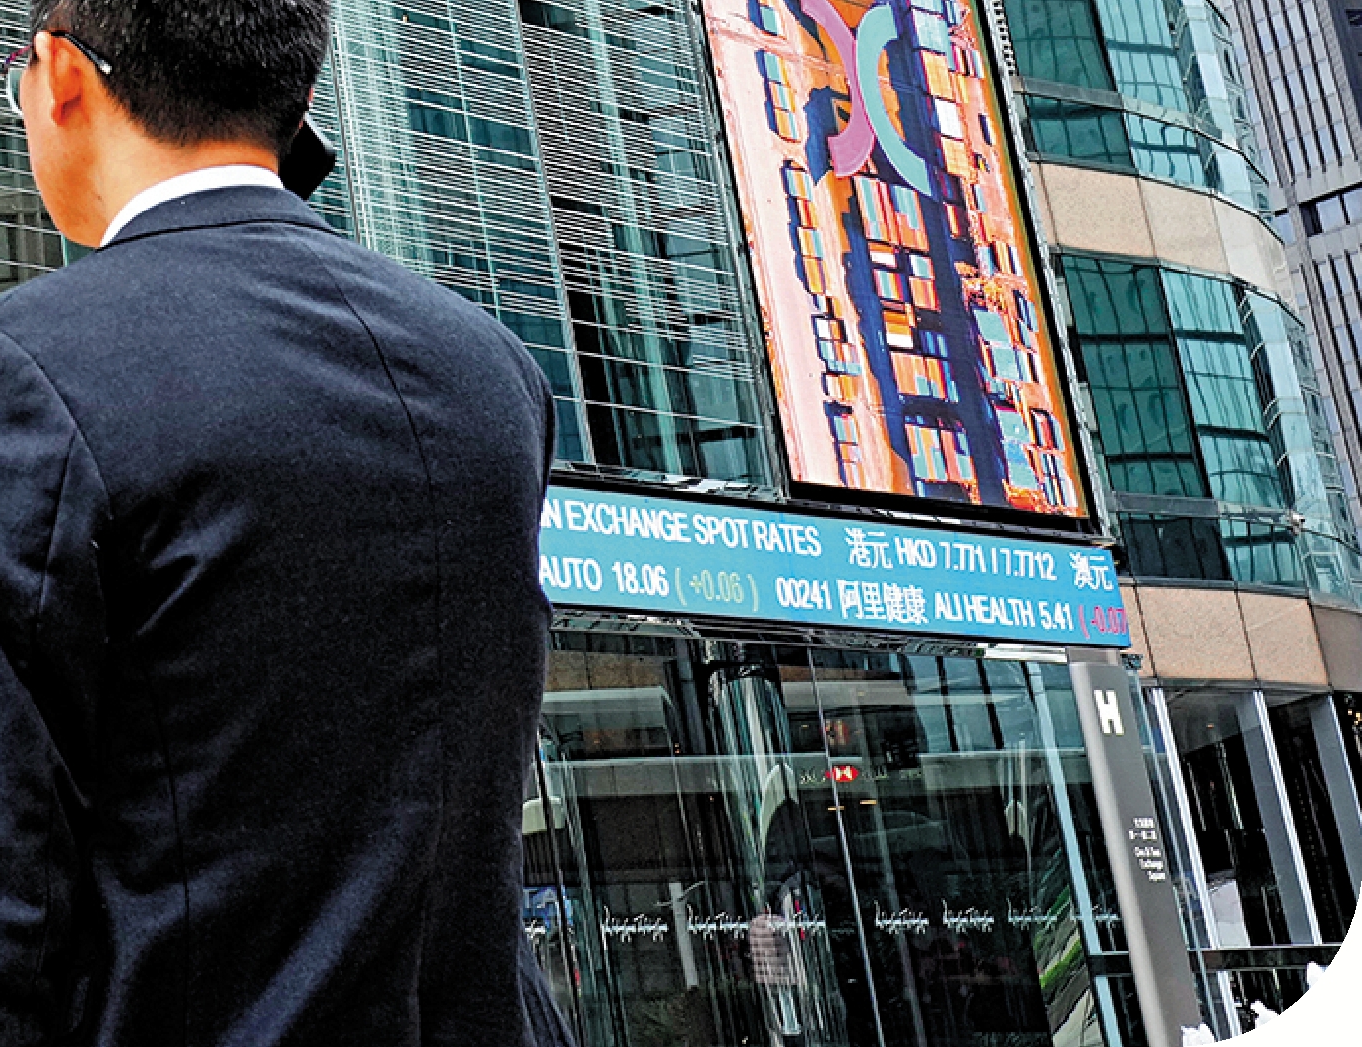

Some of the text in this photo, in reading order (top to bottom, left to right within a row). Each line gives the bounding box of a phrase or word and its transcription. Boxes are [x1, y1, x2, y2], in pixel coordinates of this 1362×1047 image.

[564, 500, 692, 543] EXCHANGE
[693, 514, 749, 548] SPOT
[752, 520, 822, 557] RATES
[845, 527, 893, 569] 港元
[895, 537, 936, 567] HKD
[538, 555, 603, 591] AUTO
[611, 561, 670, 596] 18.06
[776, 577, 832, 610] 00241
[837, 579, 928, 624] 阿里健康
[964, 594, 1036, 627] HEALTH
[1039, 602, 1074, 631] 5.41
